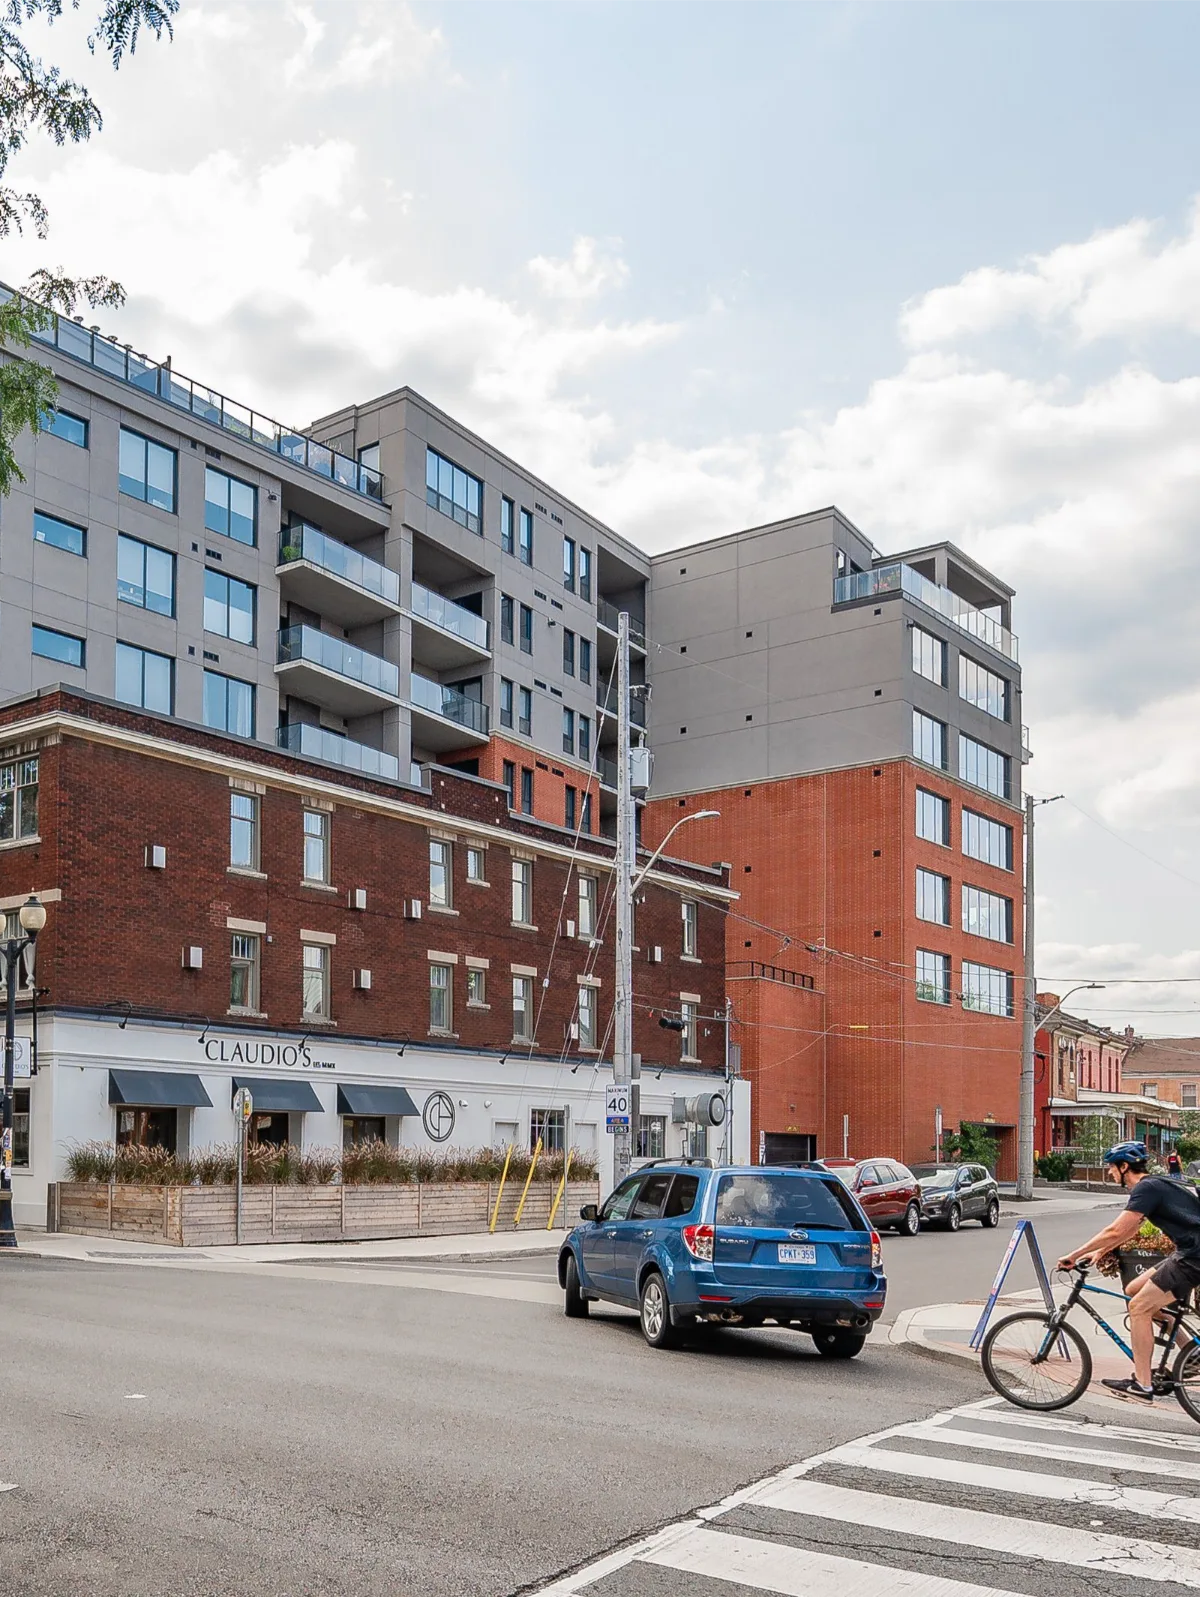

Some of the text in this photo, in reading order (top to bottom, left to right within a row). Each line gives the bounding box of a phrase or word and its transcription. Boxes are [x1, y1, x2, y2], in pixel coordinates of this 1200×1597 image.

[205, 1039, 311, 1068] CLAUDIO'S
[607, 1097, 627, 1112] 40
[779, 1249, 815, 1260] CPKT 359
